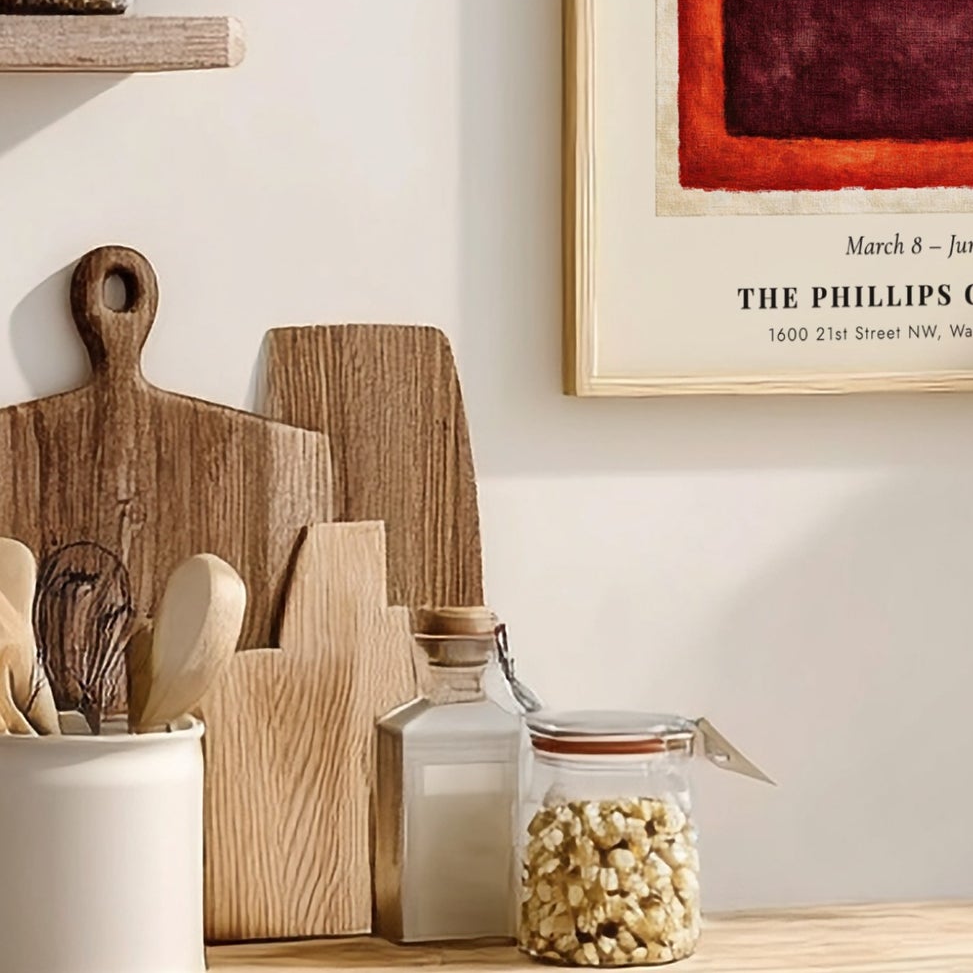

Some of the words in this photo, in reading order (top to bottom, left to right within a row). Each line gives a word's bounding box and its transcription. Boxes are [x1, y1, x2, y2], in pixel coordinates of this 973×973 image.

[845, 232, 905, 256] March
[910, 236, 923, 255] 8
[737, 287, 798, 310] THE
[811, 283, 952, 309] PHILLIPS
[768, 326, 809, 342] 1600
[815, 326, 848, 342] 21st
[855, 325, 901, 341] Street
[908, 324, 942, 341] NW,
